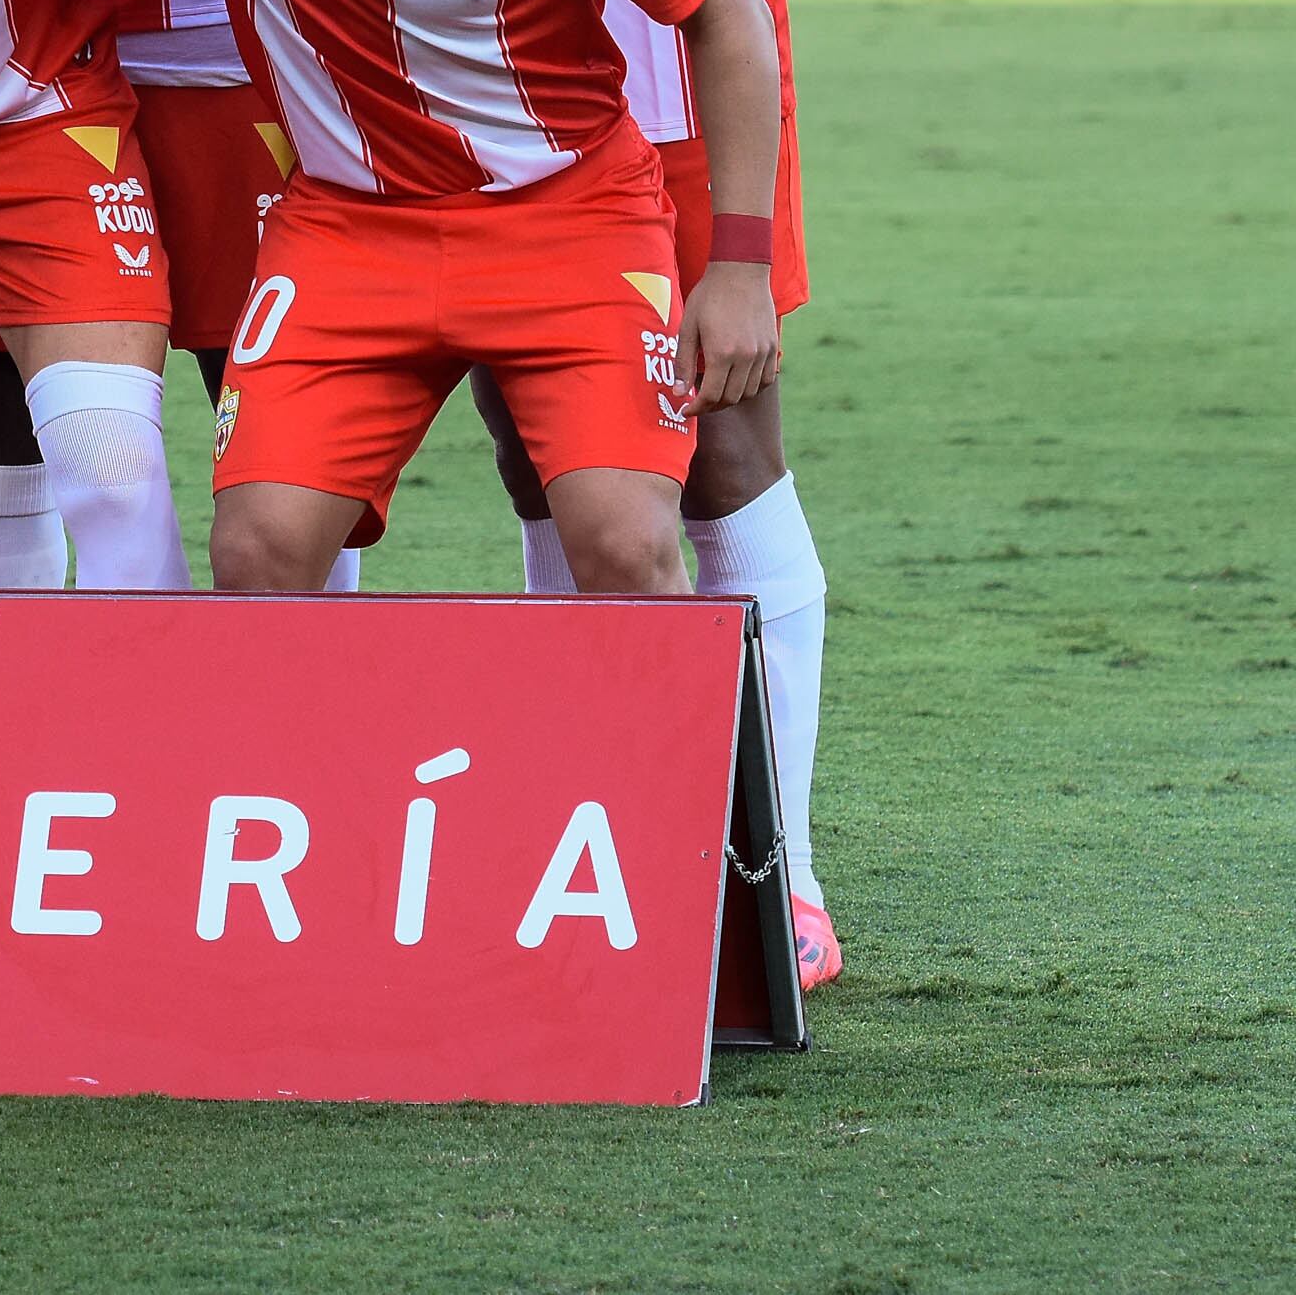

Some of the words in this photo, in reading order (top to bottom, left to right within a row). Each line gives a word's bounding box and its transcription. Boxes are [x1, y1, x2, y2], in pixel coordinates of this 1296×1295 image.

[95, 205, 155, 235] KUDU
[233, 275, 296, 364] 0
[641, 331, 679, 358] ودو
[644, 354, 675, 387] KU
